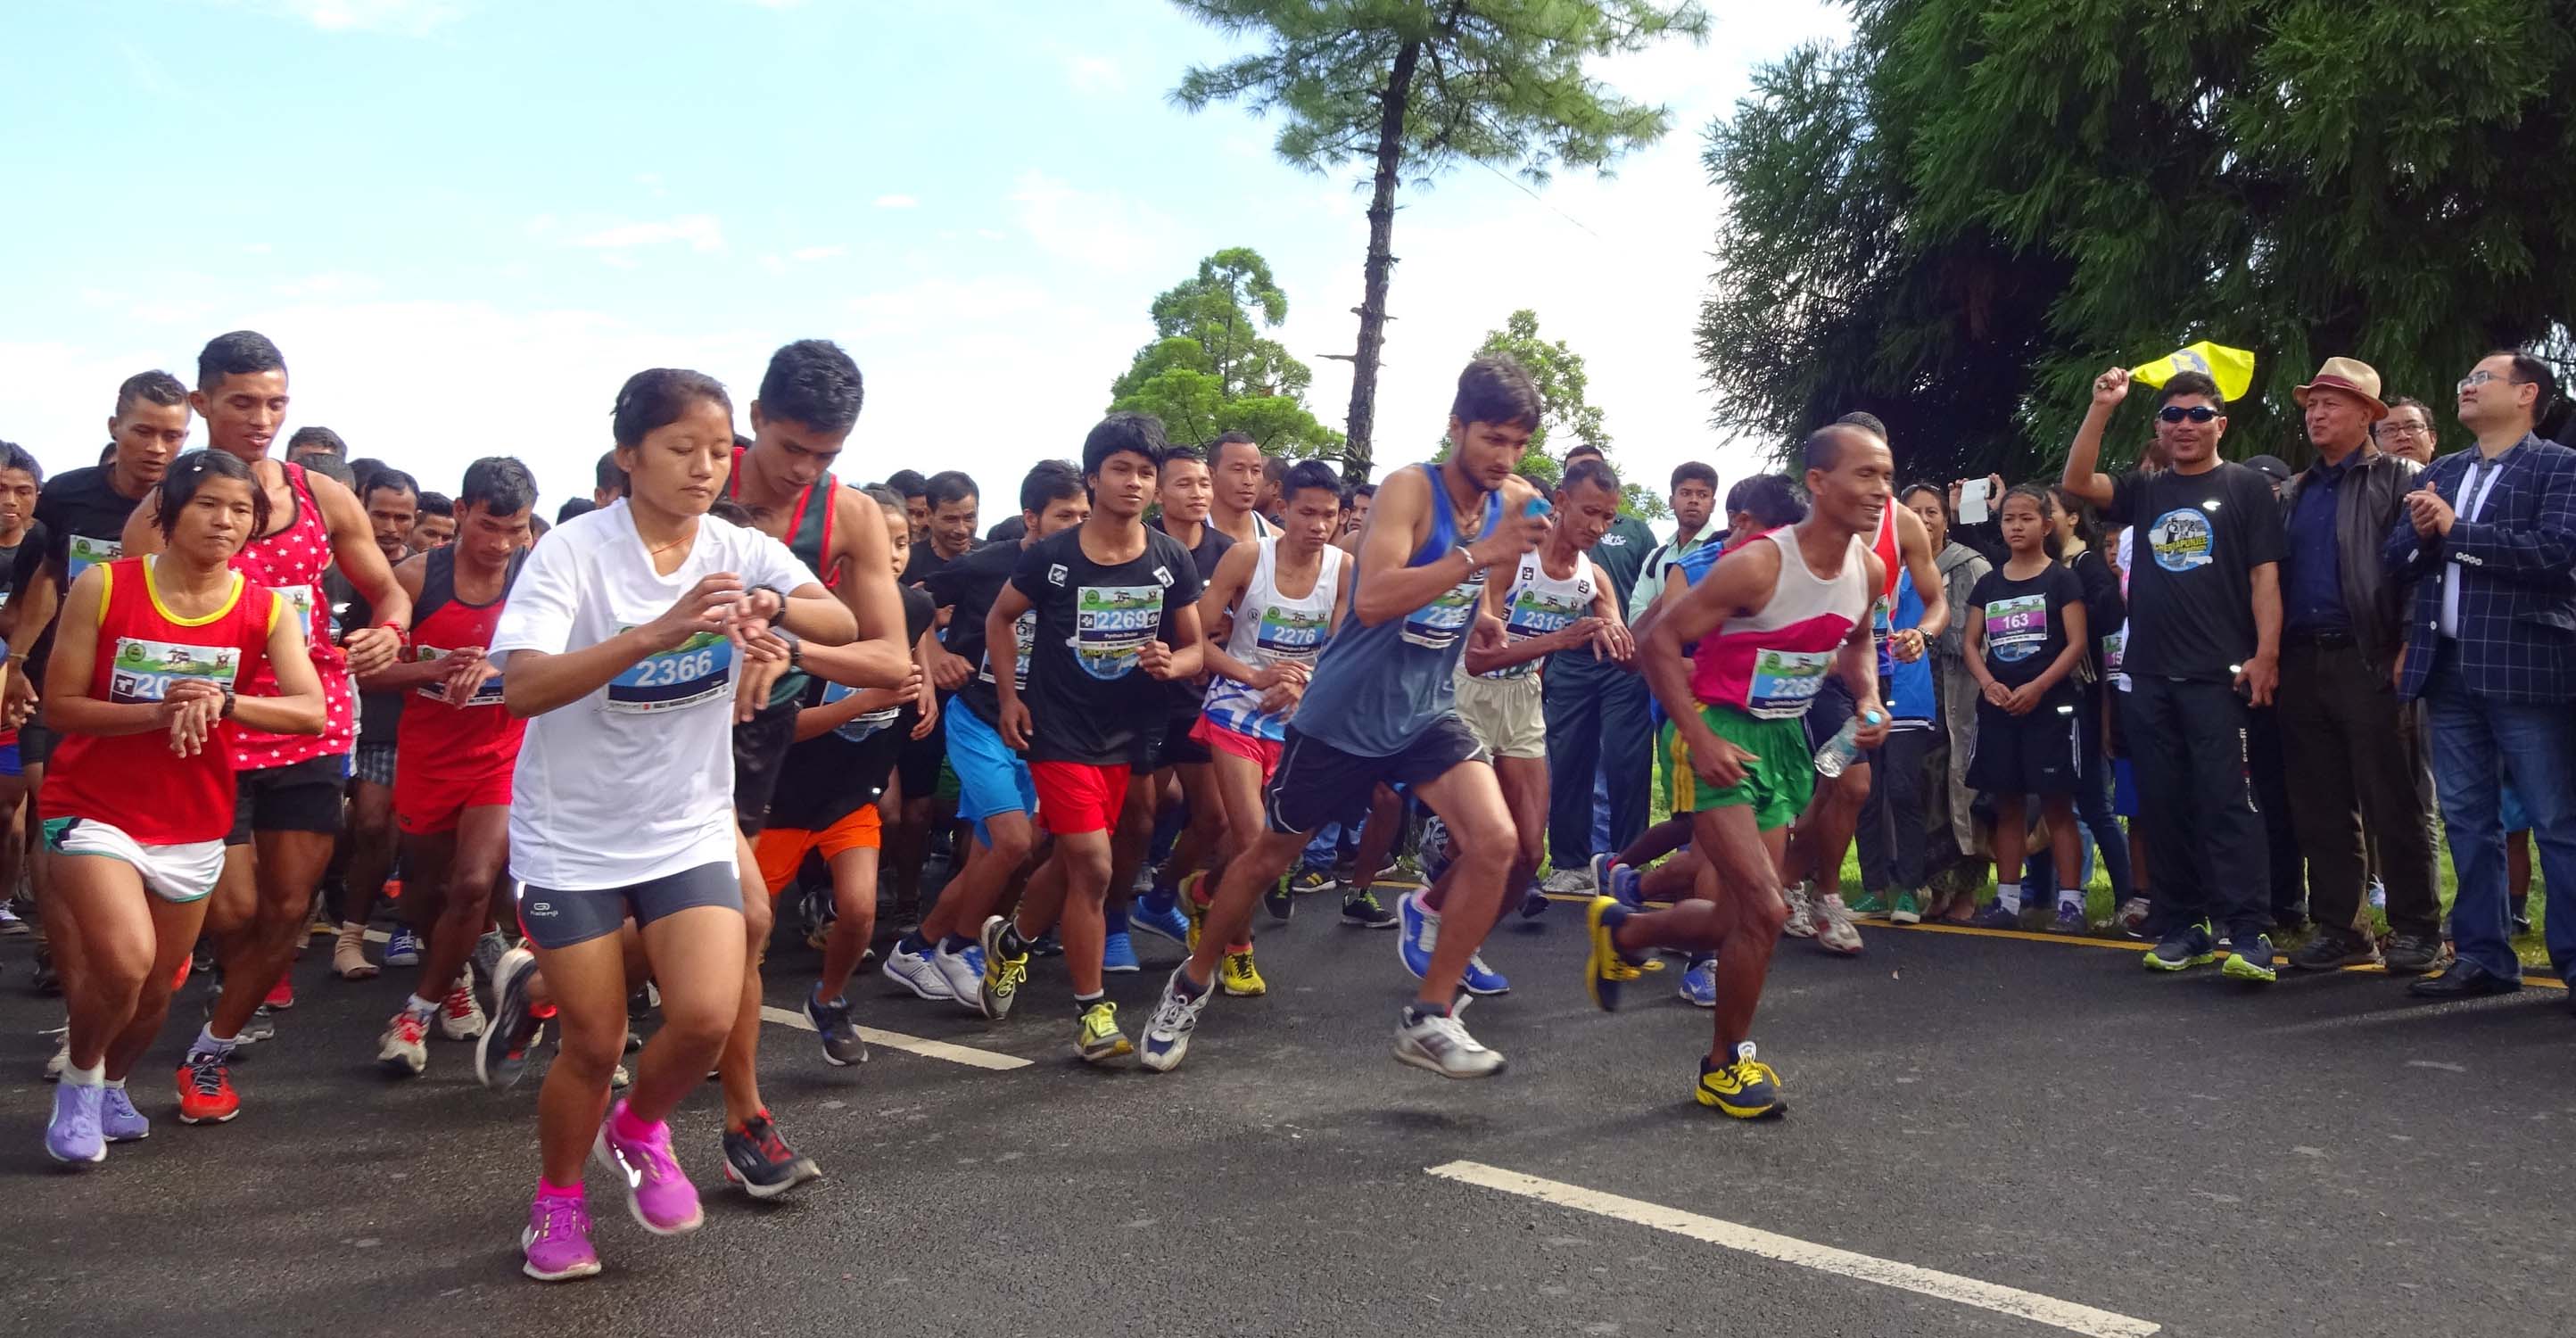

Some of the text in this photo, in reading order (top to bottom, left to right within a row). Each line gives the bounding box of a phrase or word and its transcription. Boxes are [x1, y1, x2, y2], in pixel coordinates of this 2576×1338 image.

[1098, 610, 1148, 630] 2269
[1523, 611, 1566, 632] 2315
[2002, 613, 2028, 629] 163
[1273, 625, 1316, 645] 2276
[635, 649, 713, 686] 2366
